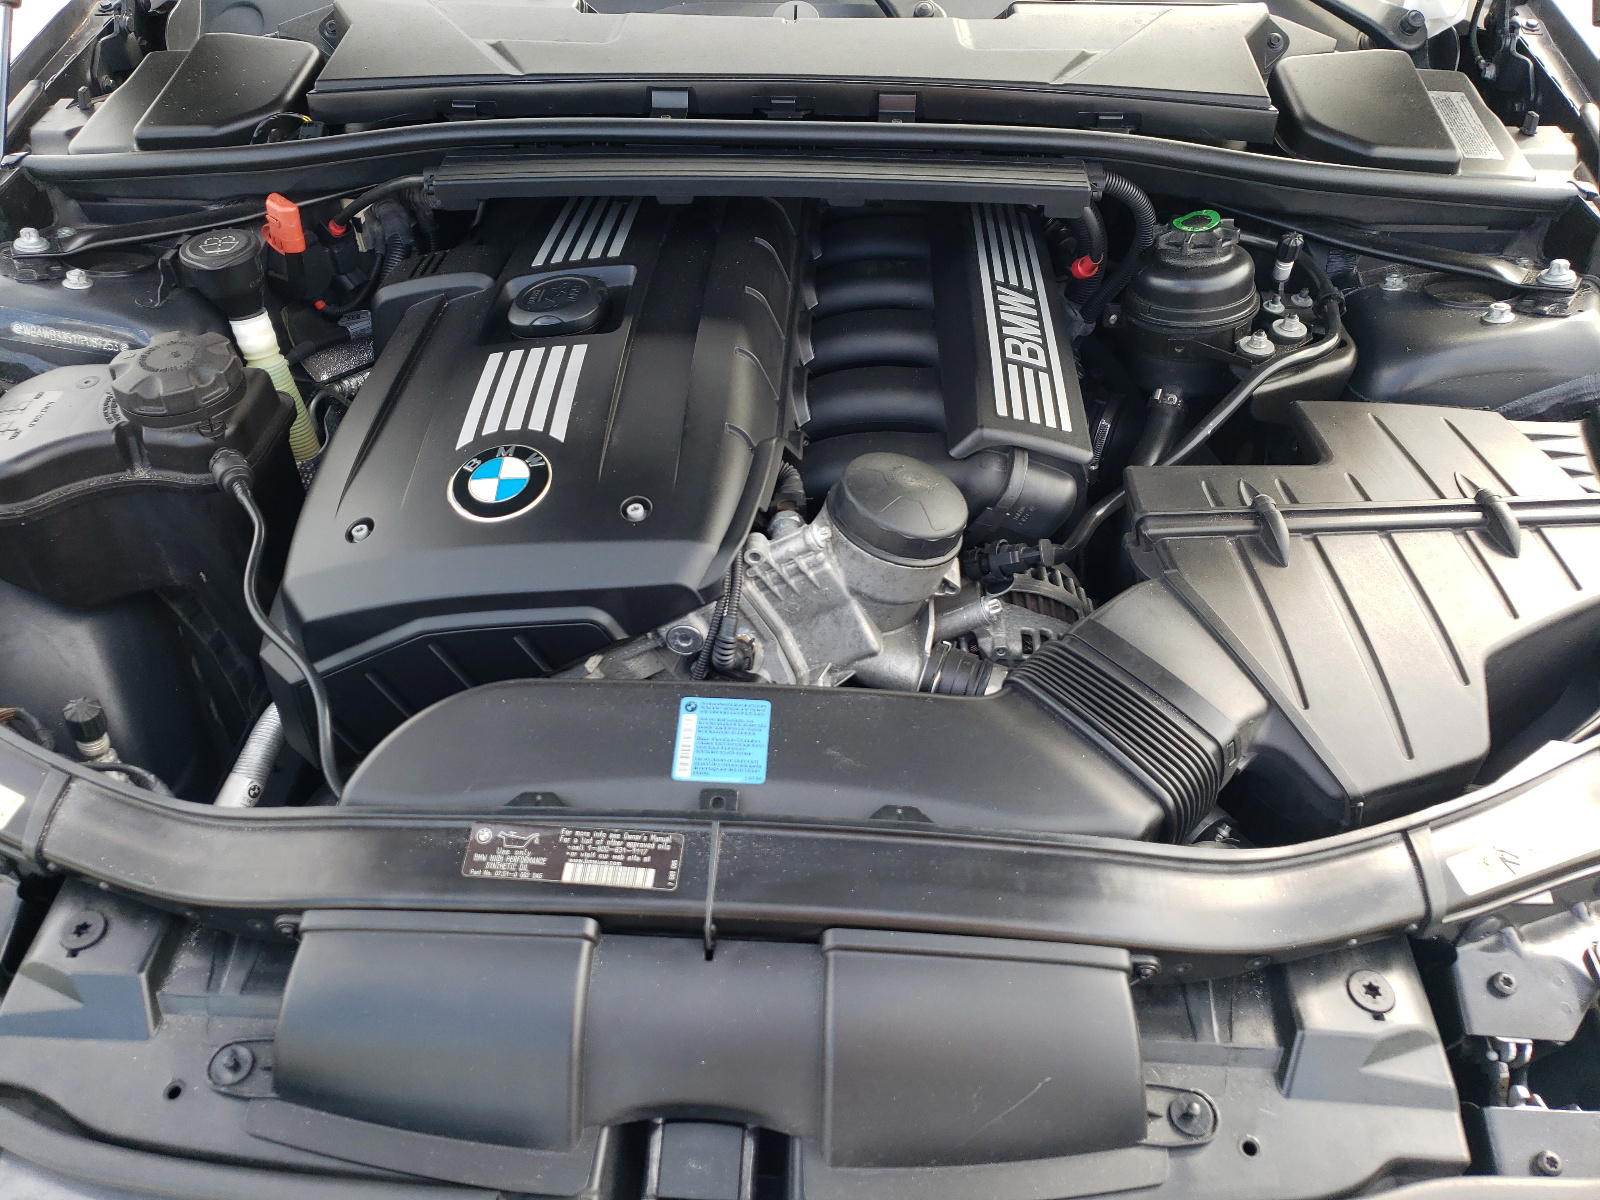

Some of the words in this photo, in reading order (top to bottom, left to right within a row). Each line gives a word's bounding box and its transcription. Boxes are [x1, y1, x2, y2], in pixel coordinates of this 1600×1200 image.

[996, 285, 1047, 368] BMW
[462, 445, 546, 472] BMW
[560, 836, 571, 844] For
[562, 828, 573, 836] For
[594, 830, 607, 839] info
[651, 835, 672, 843] Manual
